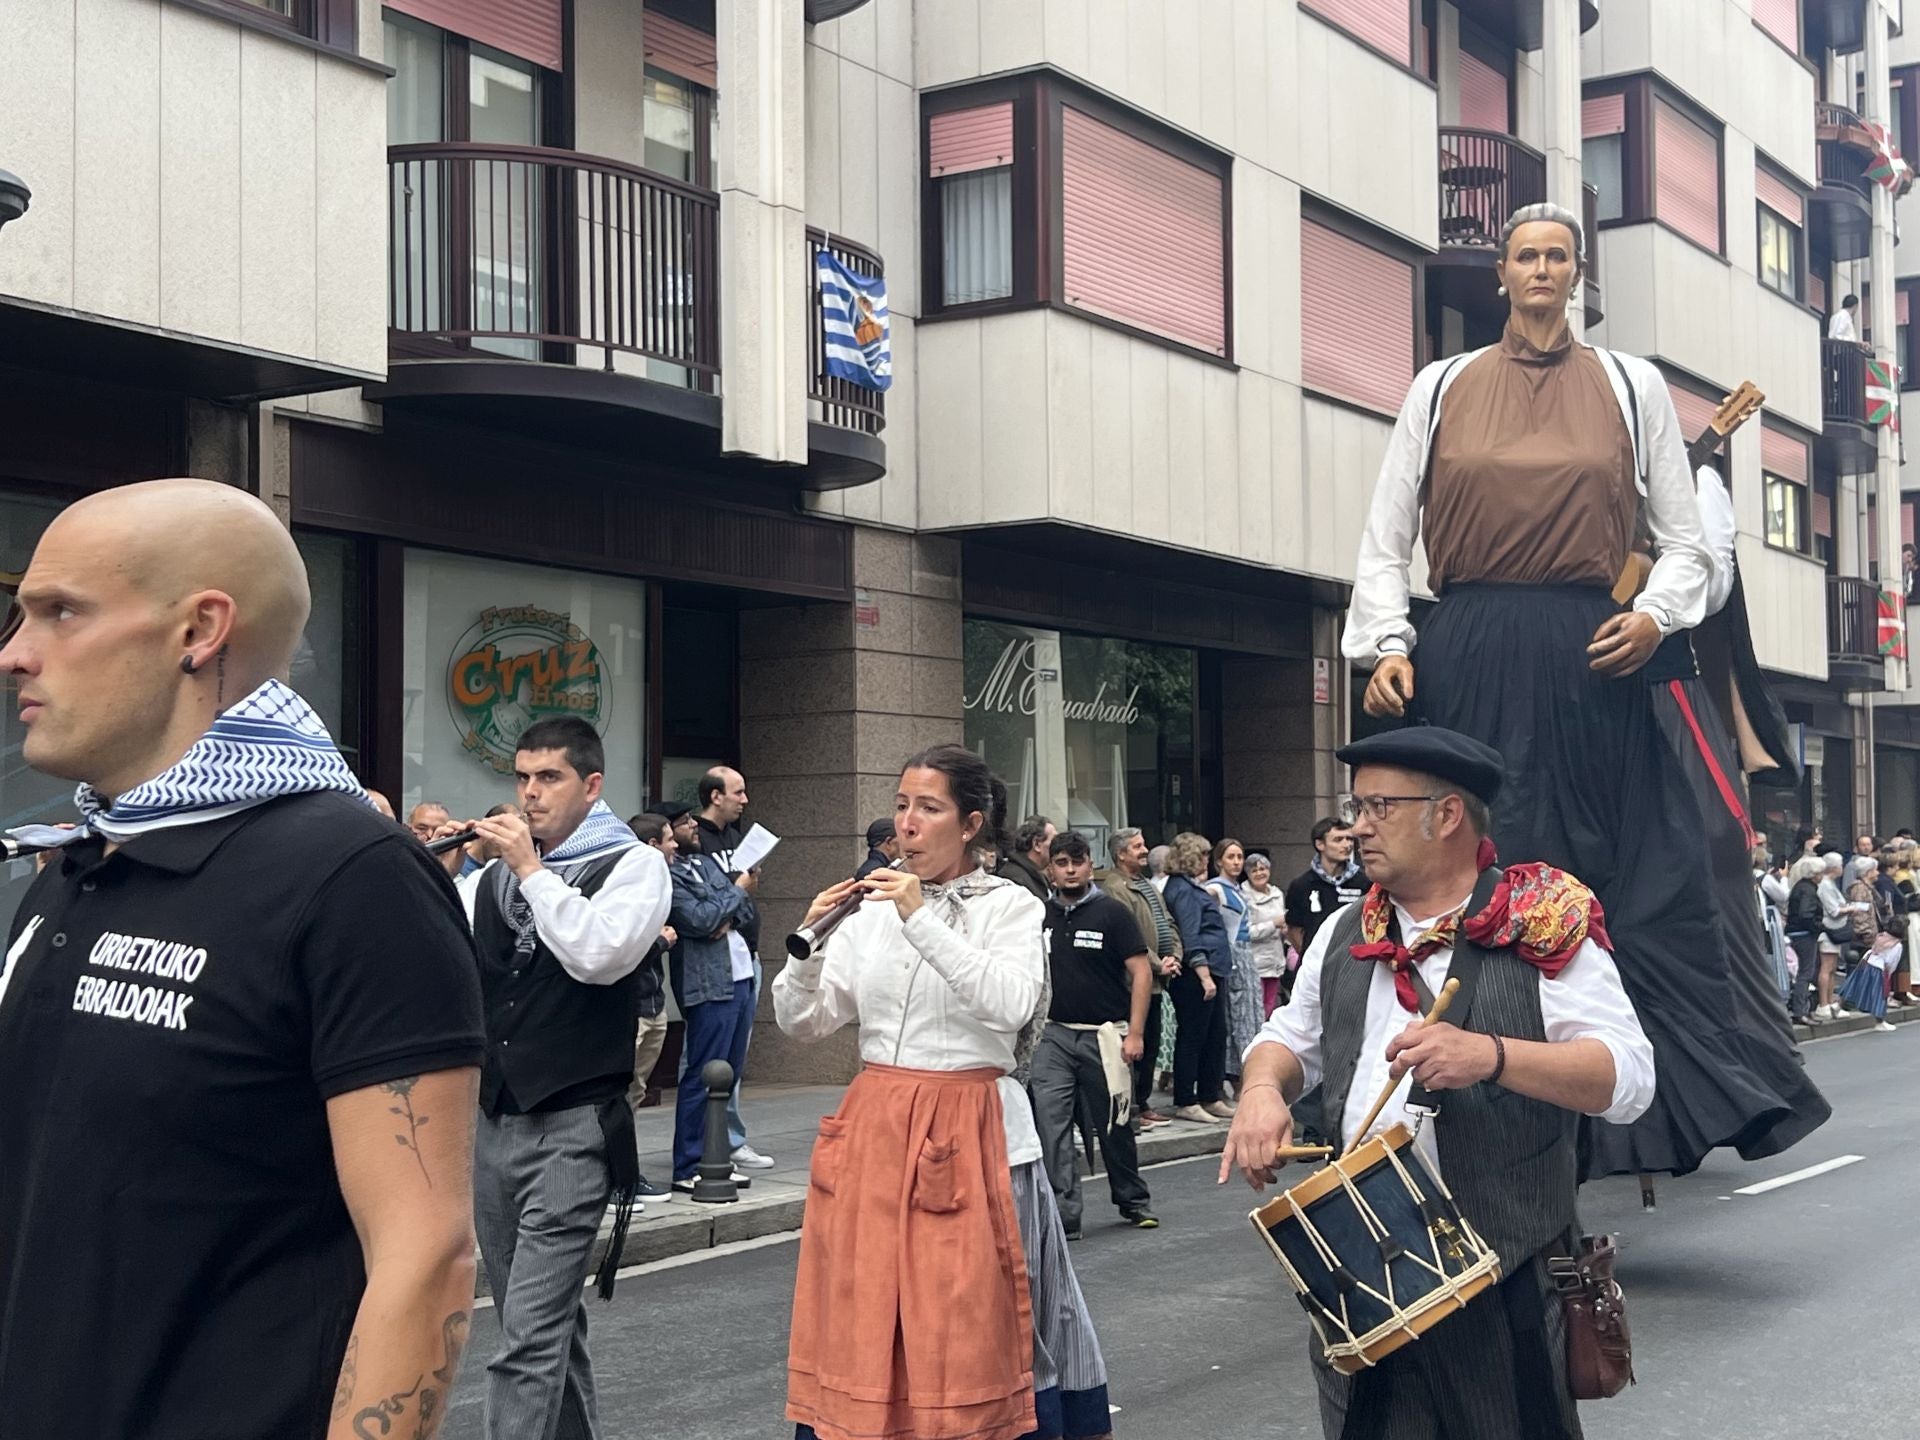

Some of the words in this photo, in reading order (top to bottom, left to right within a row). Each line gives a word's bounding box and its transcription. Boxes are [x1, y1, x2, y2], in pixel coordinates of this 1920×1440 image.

[452, 639, 599, 706] Cruz
[88, 931, 208, 983] URRETXUKO
[72, 975, 194, 1031] ERRALDOIAK
